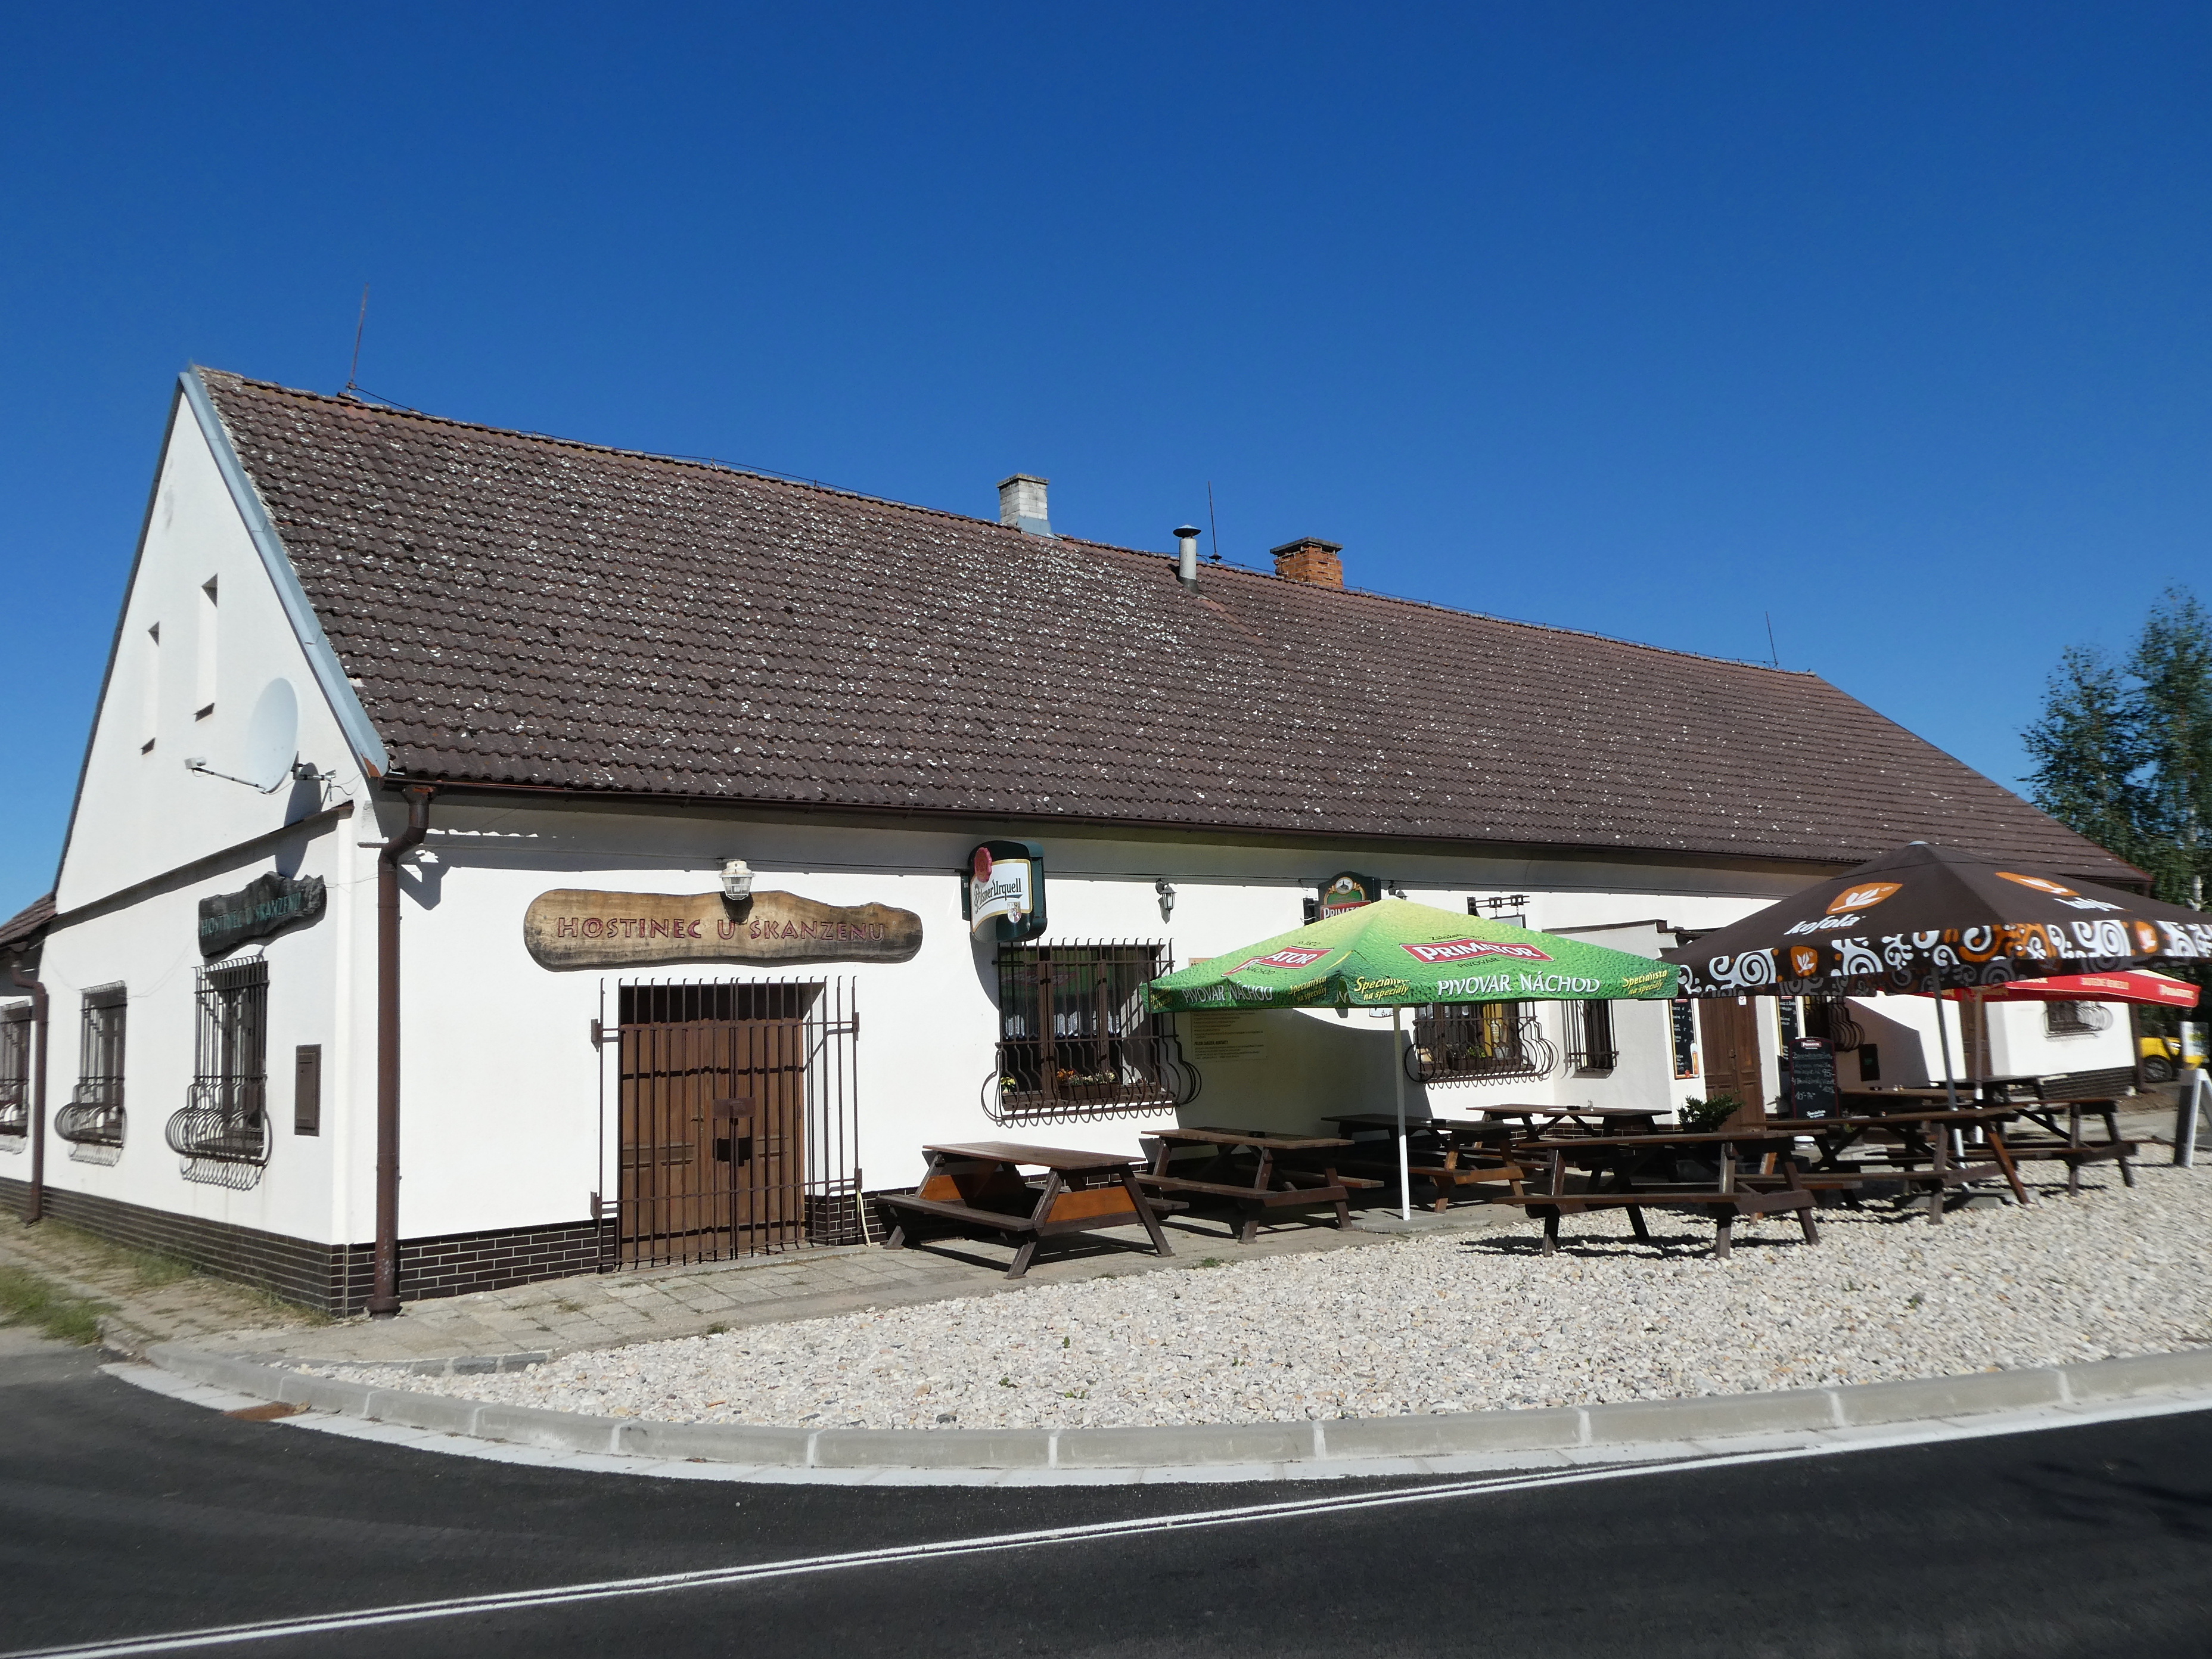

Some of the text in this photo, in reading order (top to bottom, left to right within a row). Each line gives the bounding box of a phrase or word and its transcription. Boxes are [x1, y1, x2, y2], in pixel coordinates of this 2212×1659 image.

[974, 878, 1022, 914] Pilsner Urquell
[557, 917, 886, 942] HOSTINEC U SKANZENU
[1783, 914, 1860, 935] kofola
[1412, 942, 1541, 961] PRIMATOR
[1457, 957, 1500, 968] PIVOVAR
[1437, 971, 1601, 996] PIVOVAR NÁCHOD
[1622, 970, 1668, 987] Specialista
[1182, 986, 1225, 1004] PIVOVAR
[1228, 981, 1274, 1002] NÁCHOD
[1363, 984, 1410, 1001] na speciály
